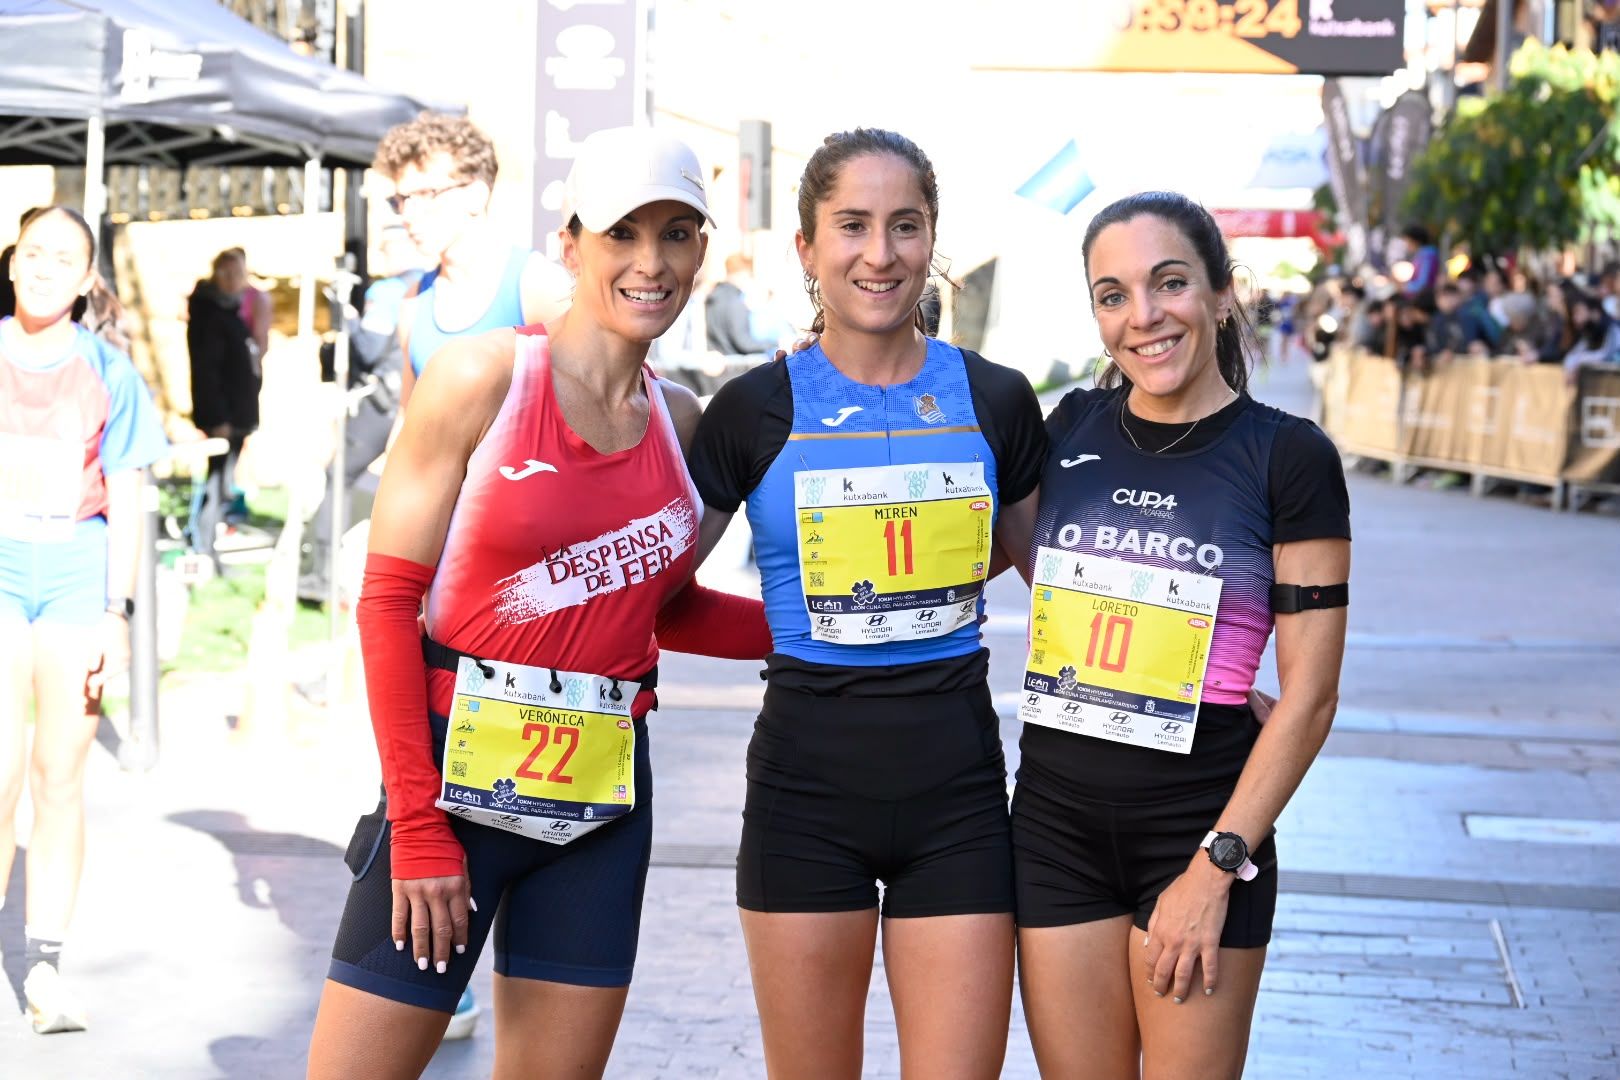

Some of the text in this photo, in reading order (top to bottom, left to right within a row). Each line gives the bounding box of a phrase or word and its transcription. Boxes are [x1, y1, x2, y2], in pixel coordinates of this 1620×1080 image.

[843, 492, 888, 501] kutxabank
[945, 485, 985, 495] kutxabank
[874, 506, 918, 520] MIREN
[541, 543, 572, 563] LA
[545, 520, 673, 584] DESPENSA
[883, 520, 913, 577] 11
[1058, 524, 1224, 570] O BARCO
[584, 545, 674, 593] DE FER
[1072, 578, 1113, 592] kutxabank
[1092, 598, 1138, 617] LORETO
[1166, 595, 1211, 611] kutxabank
[861, 627, 893, 635] HYUNDAI
[911, 622, 941, 630] HYUNDAI
[1085, 612, 1134, 673] 10
[504, 688, 547, 702] kutxabank
[519, 708, 585, 728] VERÓNICA
[1056, 713, 1085, 724] HYUNDAI
[1103, 722, 1134, 734] HYUNDAI
[1154, 733, 1187, 743] HYUNDAI
[515, 722, 579, 784] 22
[541, 830, 573, 838] HYUNDAI
